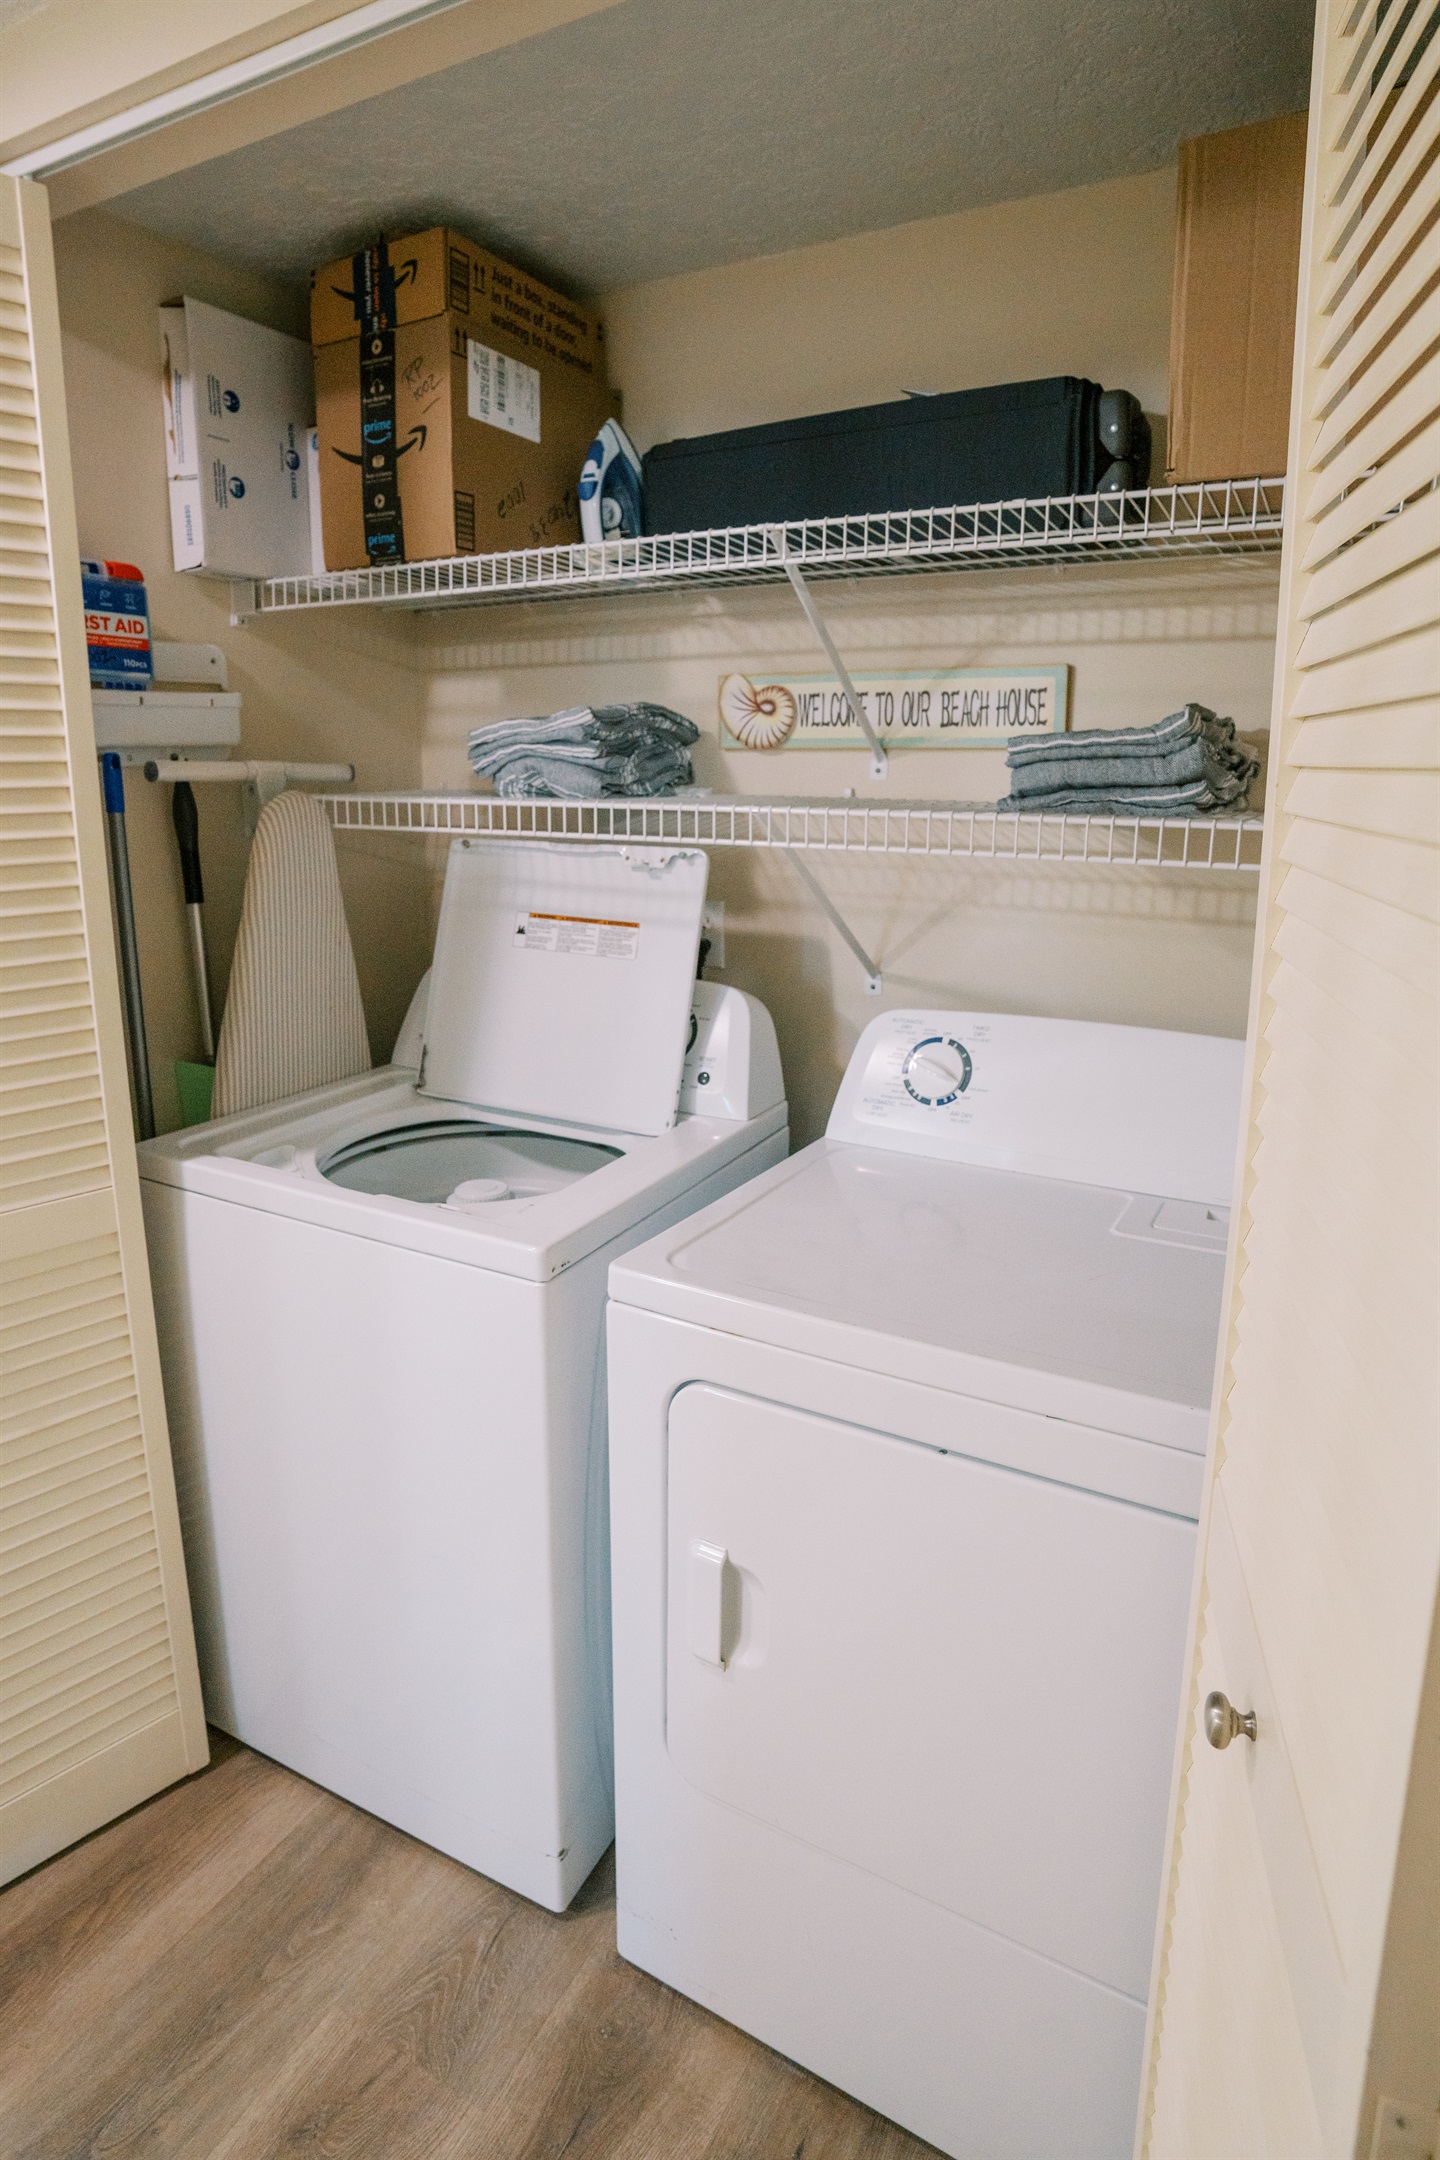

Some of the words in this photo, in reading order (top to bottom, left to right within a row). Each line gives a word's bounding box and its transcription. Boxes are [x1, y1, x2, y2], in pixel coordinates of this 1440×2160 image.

[490, 286, 502, 305] in
[504, 294, 532, 322] front
[532, 313, 545, 329] of
[491, 266, 513, 290] Just
[515, 281, 523, 296] a
[547, 301, 588, 335] standing
[490, 312, 529, 346] waiting
[531, 331, 543, 349] to
[544, 337, 557, 357] be
[558, 348, 594, 375] opened
[363, 419, 392, 434] prime
[367, 533, 396, 547] prime
[114, 617, 145, 635] AID
[875, 691, 894, 727] TO
[901, 690, 932, 728] OUR
[940, 690, 990, 728] BEACH
[995, 687, 1048, 728] HOUSE
[891, 1017, 926, 1026] AUTOMATIC
[862, 1097, 897, 1108] AUTOMATIC
[950, 1110, 960, 1118] AIR
[961, 1111, 974, 1119] DRY
